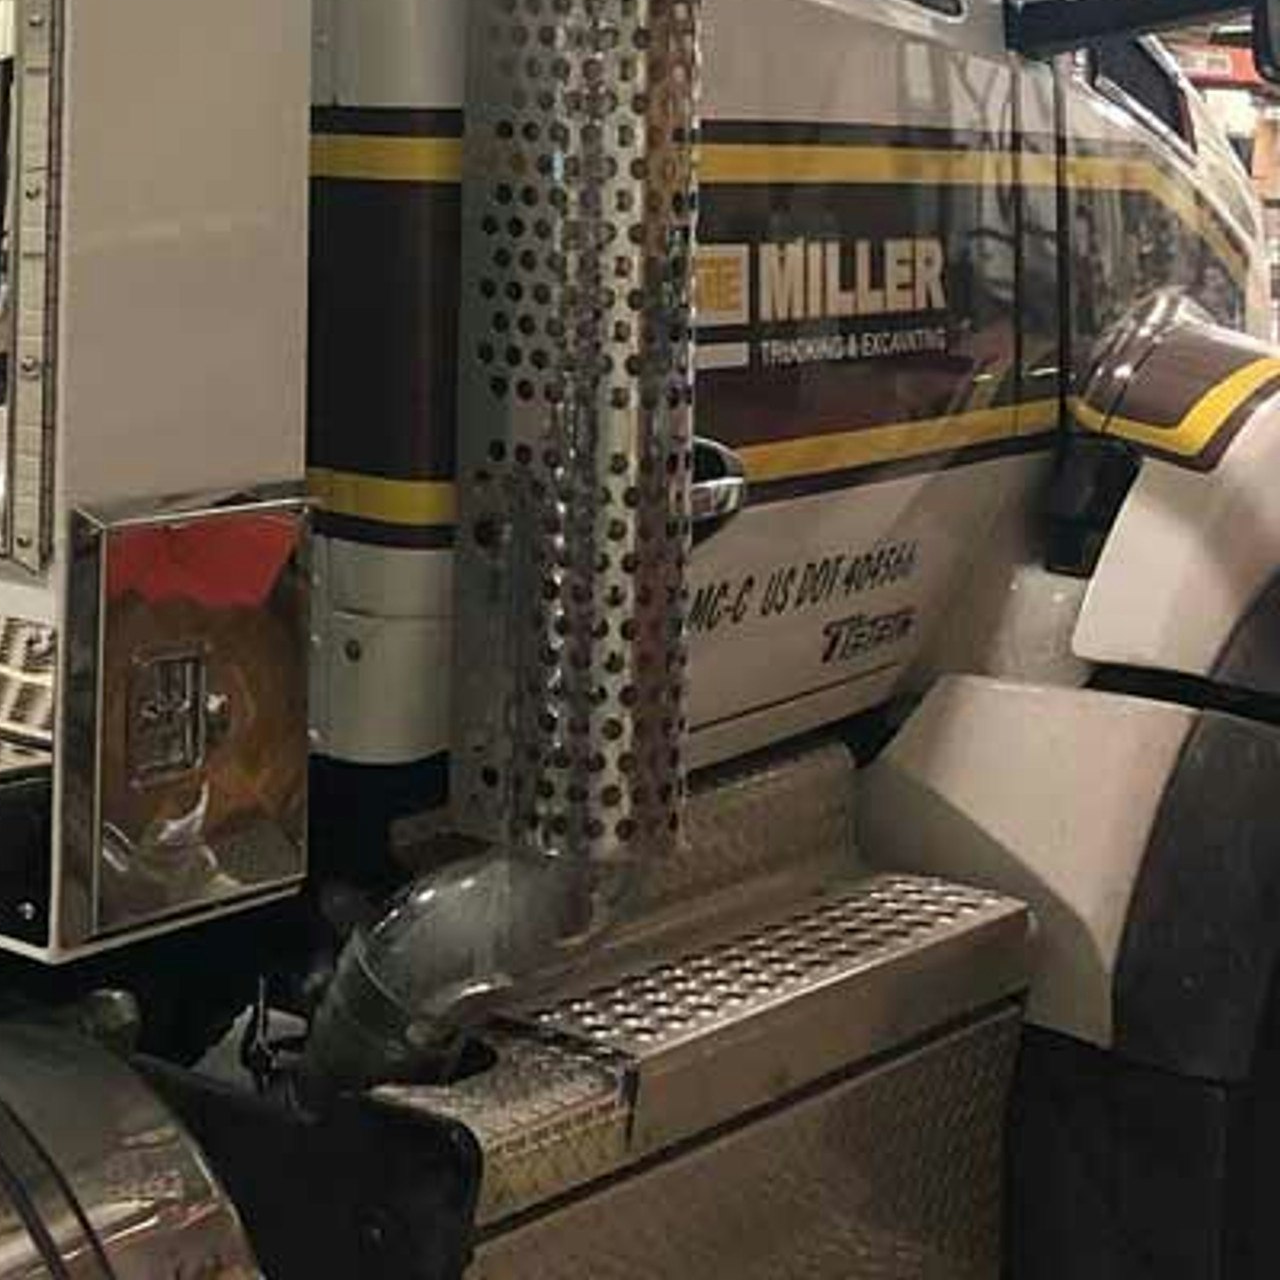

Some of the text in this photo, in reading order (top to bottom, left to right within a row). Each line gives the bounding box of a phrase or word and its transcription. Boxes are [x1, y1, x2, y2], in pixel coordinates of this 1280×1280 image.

[758, 237, 946, 321] MILLER
[761, 566, 797, 616] US
[793, 553, 846, 609] DOT
